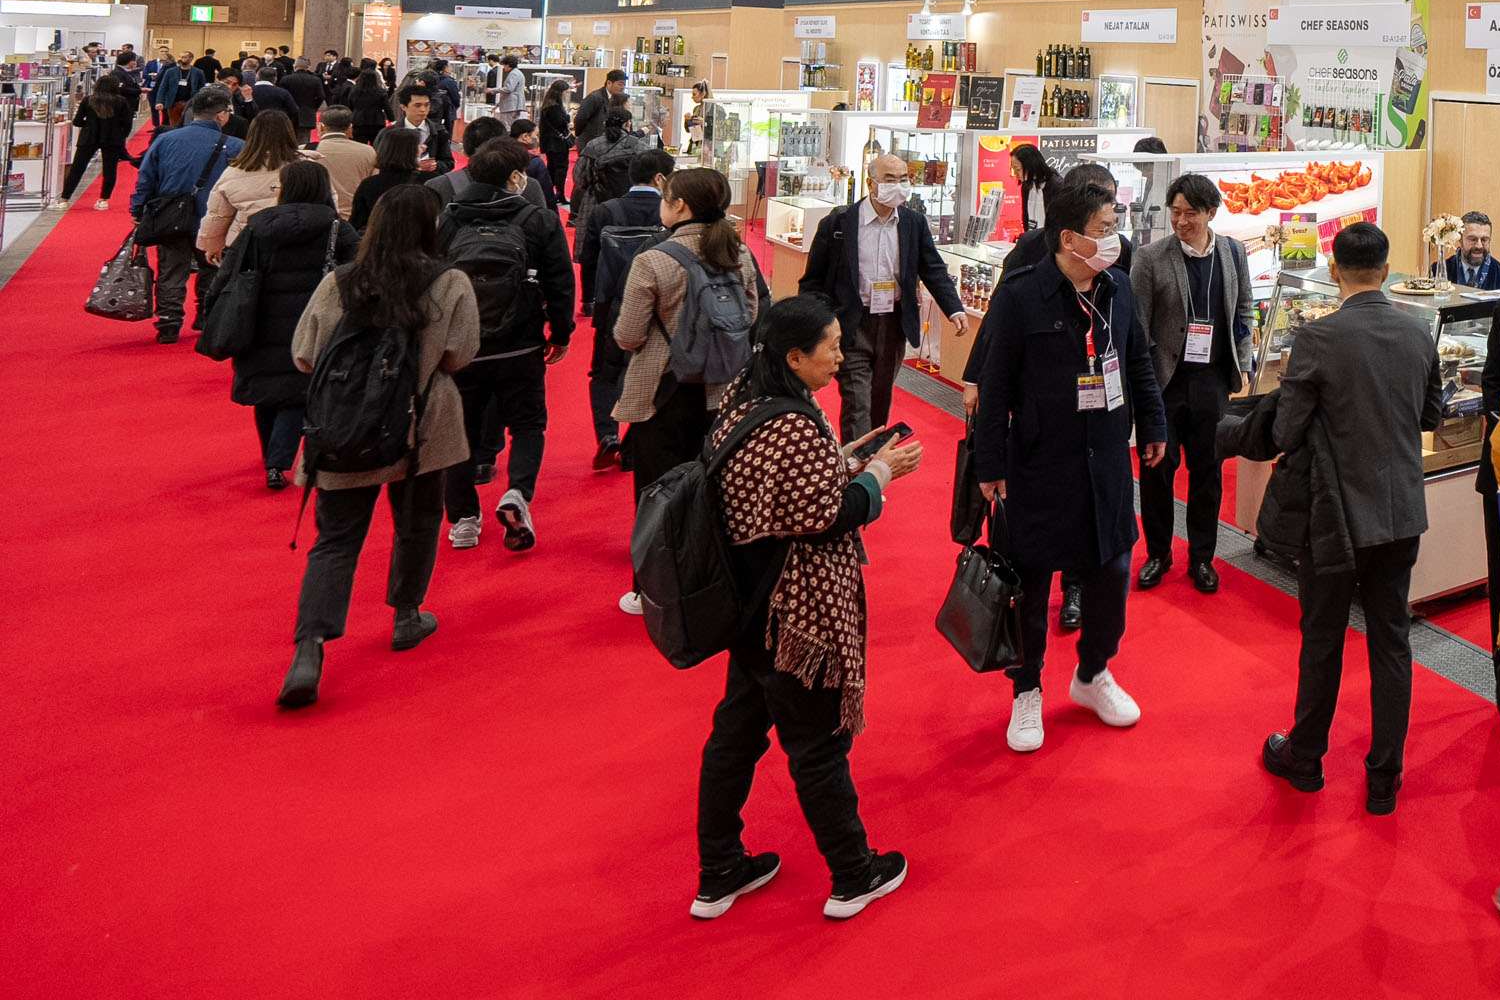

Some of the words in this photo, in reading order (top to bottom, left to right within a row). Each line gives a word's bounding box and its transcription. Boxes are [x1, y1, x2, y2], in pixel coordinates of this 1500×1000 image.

[1104, 21, 1124, 31] NEJAT
[1125, 21, 1150, 31] ATALAN
[1204, 14, 1267, 28] PATISWISS
[1300, 20, 1324, 31] CHEF
[1326, 19, 1369, 31] SEASONS
[1042, 139, 1096, 148] PATISWISS
